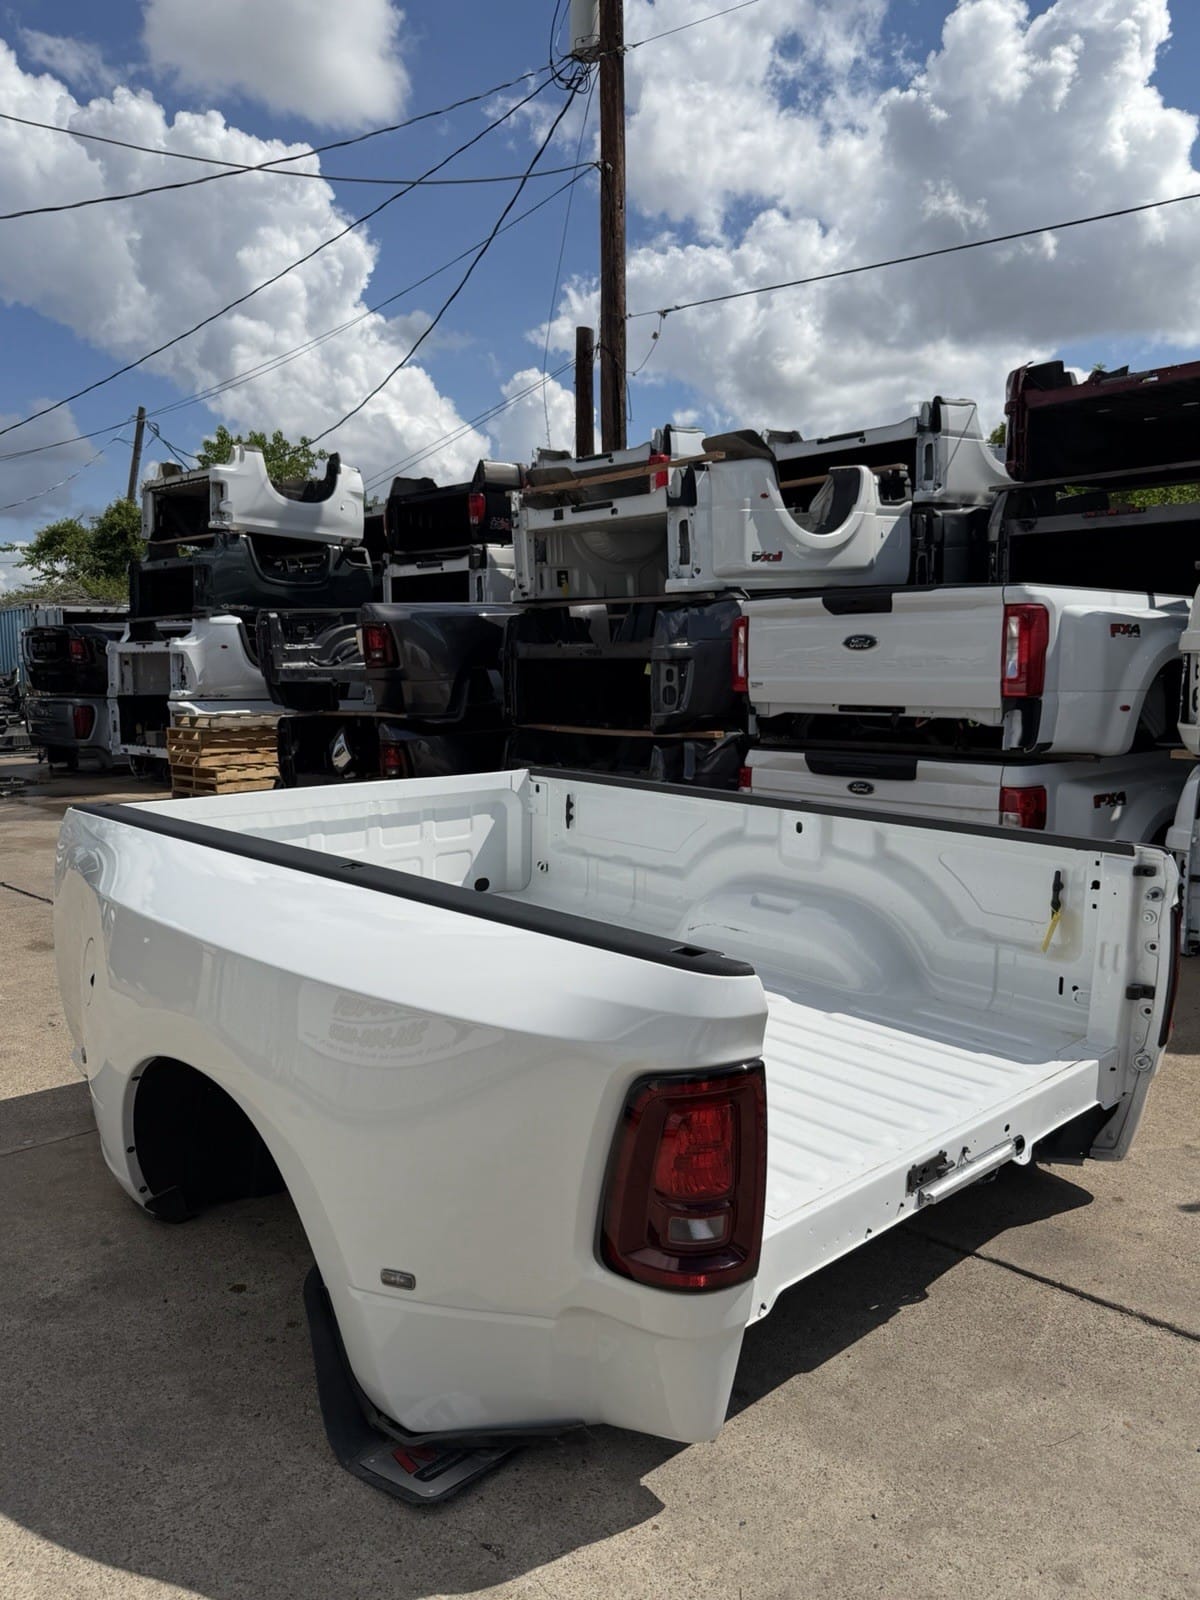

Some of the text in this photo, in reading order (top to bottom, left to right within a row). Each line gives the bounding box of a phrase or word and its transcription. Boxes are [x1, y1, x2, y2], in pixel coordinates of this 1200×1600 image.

[752, 551, 783, 562] FX4
[1110, 624, 1141, 638] FX4
[847, 636, 871, 648] Ford
[1093, 791, 1126, 808] FX4
